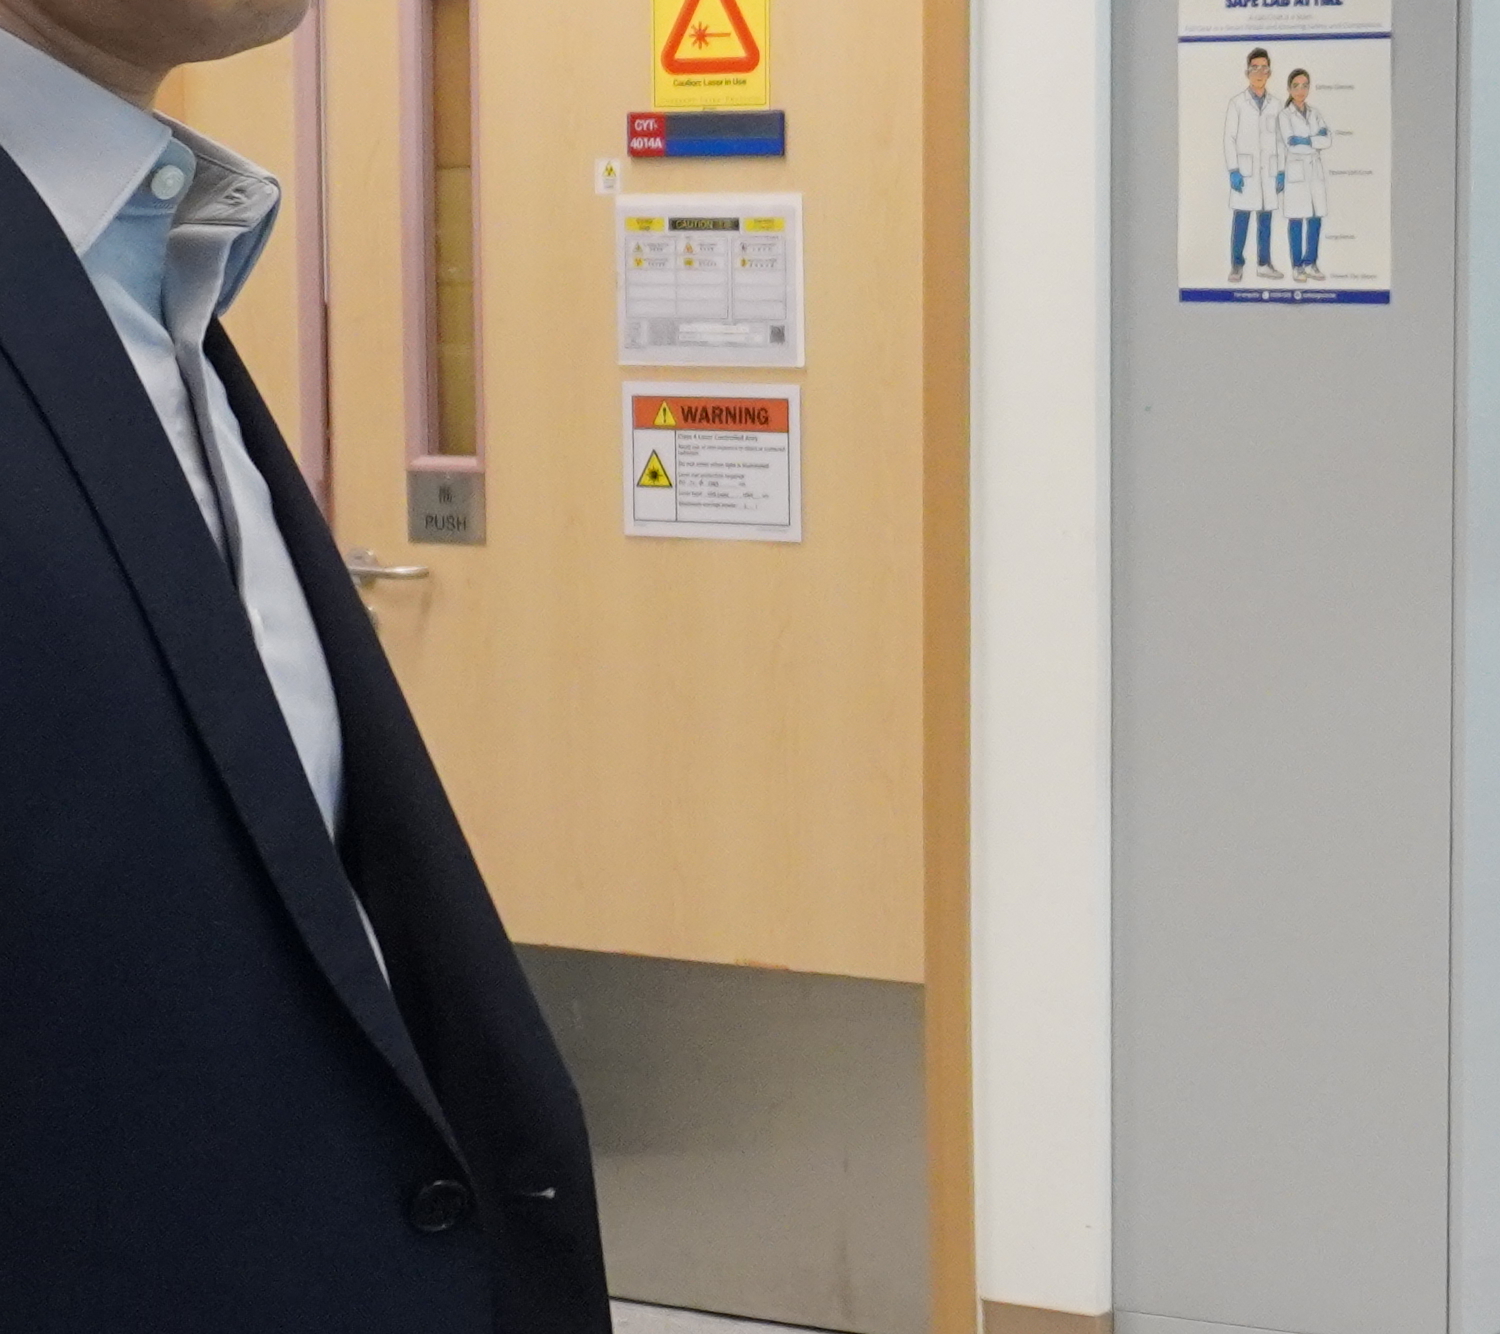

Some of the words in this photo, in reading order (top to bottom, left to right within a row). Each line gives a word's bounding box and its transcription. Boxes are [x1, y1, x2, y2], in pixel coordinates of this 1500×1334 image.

[703, 78, 723, 86] Laser
[732, 77, 747, 85] Use
[629, 137, 662, 149] 4014A
[675, 219, 713, 230] CAUTION
[680, 405, 769, 426] WARNING
[425, 514, 467, 531] PUSH
